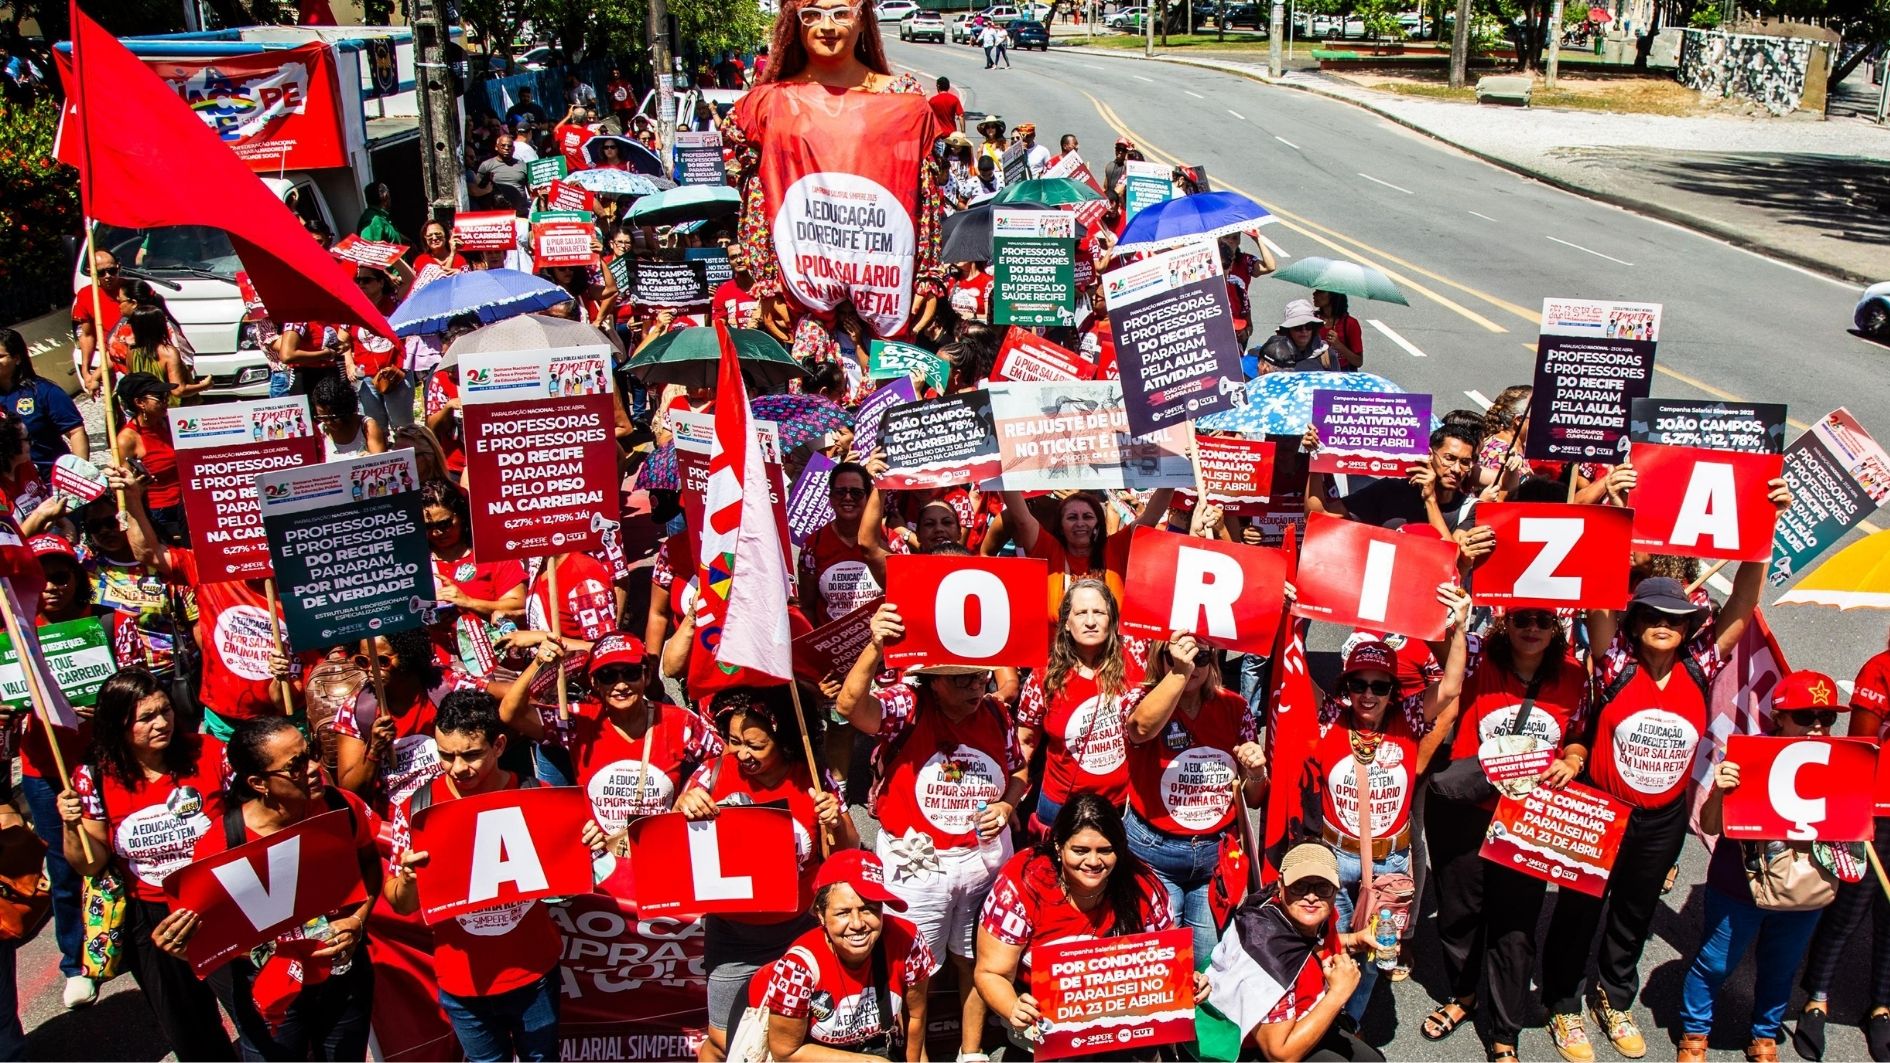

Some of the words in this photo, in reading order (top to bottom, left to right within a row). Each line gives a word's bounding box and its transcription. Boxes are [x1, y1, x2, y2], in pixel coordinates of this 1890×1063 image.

[805, 198, 812, 218] A
[812, 201, 886, 231] EDUCAÇÃO
[460, 226, 512, 236] VALORIZAÇÃO
[461, 232, 473, 240] DA
[474, 232, 512, 240] CARREIRA!
[796, 221, 817, 241] DO
[816, 225, 860, 250] RECIFE
[863, 231, 893, 254] TEM
[999, 256, 1005, 264] E
[1006, 256, 1069, 266] PROFESSORES
[1001, 247, 1066, 256] PROFESSORAS
[638, 269, 659, 278] JOÃO
[1009, 265, 1024, 273] DO
[1025, 265, 1056, 274] RECIFE
[1010, 274, 1055, 283] PARARAM
[637, 284, 647, 293] NA
[647, 285, 688, 293] CARREIRA
[688, 283, 700, 292] JÁ!
[1001, 283, 1015, 291] EM
[1017, 283, 1051, 292] DEFESA
[1052, 284, 1066, 292] DO
[1001, 289, 1032, 300] SAÚDE
[1033, 292, 1066, 301] RECIFE!
[1122, 293, 1215, 331] PROFESSORAS
[1120, 333, 1130, 345] E
[1131, 305, 1222, 344] PROFESSORES
[1141, 336, 1206, 365] PARARAM
[1547, 350, 1642, 366] PROFESSORAS
[1143, 360, 1218, 392] ATIVIDADE!
[1556, 376, 1577, 387] DO
[1579, 378, 1625, 391] RECIFE
[1556, 389, 1621, 403] PARARAM
[888, 416, 920, 434] JOÃO
[921, 406, 976, 426] CAMPOS,
[1332, 404, 1349, 414] EM
[1351, 405, 1394, 416] DEFESA
[1395, 406, 1413, 416] DA
[1551, 401, 1583, 412] PELA
[1584, 403, 1626, 416] AULA-
[481, 413, 600, 436] PROFESSORAS
[1004, 415, 1083, 438] REAJUSTE
[1087, 413, 1108, 430] DE
[1324, 414, 1420, 429] AULA-ATIVIDADE,
[1334, 426, 1388, 437] PARALISEI
[1390, 428, 1407, 438] NO
[1549, 413, 1625, 428] ATIVIDADE!
[1656, 415, 1698, 432] JOÃO
[1699, 418, 1765, 434] CAMPOS,
[476, 440, 487, 452] E
[490, 429, 606, 451] PROFESSORES
[1328, 435, 1348, 446] DIA
[1349, 436, 1361, 446] 23
[1363, 437, 1379, 448] DE
[1380, 438, 1415, 449] ABRIL!
[194, 454, 303, 476] PROFESSORAS
[497, 453, 524, 467] DO
[527, 446, 584, 465] RECIFE
[501, 461, 583, 482] PARARAM
[1797, 447, 1858, 515] PROFESSORAS
[1207, 481, 1222, 490] DE
[1223, 483, 1257, 492] ABRIL!
[1782, 471, 1800, 489] DO
[1796, 486, 1829, 522] RECIFE
[1784, 453, 1795, 464] E
[1790, 460, 1851, 526] PROFESSORES
[488, 499, 515, 515] NA
[516, 490, 604, 511] CARREIRA!
[1669, 461, 1740, 550] A
[217, 514, 257, 534] PELO
[285, 510, 408, 543] PROFESSORAS
[281, 546, 293, 557] E
[296, 522, 416, 555] PROFESSORES
[305, 552, 333, 567] DO
[336, 540, 395, 561] RECIFE
[1512, 517, 1585, 601] Z
[310, 554, 394, 580] PARARAM
[293, 581, 331, 597] POR
[334, 563, 418, 589] INCLUSÃO
[828, 582, 837, 591] DO
[837, 582, 859, 591] RECIFE
[859, 581, 873, 590] TEM
[1357, 540, 1396, 623] I
[302, 595, 328, 609] DE
[329, 577, 415, 604] VERDADE!
[1169, 546, 1244, 640] R
[935, 569, 1011, 658] O
[814, 636, 841, 652] PELO
[840, 622, 865, 639] PISO
[57, 662, 113, 686] CARREIRA!
[1860, 688, 1886, 704] CUT
[1630, 732, 1641, 744] DO
[1641, 736, 1668, 749] RECIFE
[1670, 740, 1686, 750] TEM
[1184, 762, 1190, 773] A
[1190, 759, 1227, 774] EDUCAÇÃO
[1171, 783, 1178, 793] O
[1178, 783, 1199, 797] PIOR
[1178, 773, 1189, 784] DO
[1190, 774, 1213, 785] RECIFE
[1216, 773, 1230, 784] TEM
[1344, 775, 1354, 787] DO
[1380, 776, 1394, 789] TEM
[603, 786, 615, 797] DO
[616, 787, 637, 798] RECIF
[644, 788, 660, 798] TEM
[1768, 741, 1832, 841] Ç
[924, 797, 940, 810] EM
[941, 798, 971, 810] LINHA
[1531, 787, 1553, 802] OR
[1553, 794, 1616, 823] CONDIÇÕES
[133, 825, 139, 836] A
[140, 818, 188, 836] EDUCAÇÃO
[1523, 811, 1582, 839] PARALISEI
[1582, 832, 1599, 846] NO
[1525, 799, 1544, 815] DE
[1546, 805, 1607, 836] TRABALHO,
[128, 836, 141, 848] DO
[143, 830, 175, 847] RECIFE
[177, 826, 196, 841] TEM
[468, 806, 549, 904] A
[687, 821, 754, 901] L
[211, 834, 300, 933] V
[1051, 960, 1086, 977] POR
[1087, 946, 1176, 972] CONDIÇÕES
[1060, 949, 1094, 959] Campanha
[1094, 945, 1117, 955] Salarial
[1059, 977, 1083, 991] DE
[1083, 963, 1169, 985] TRABALHO,
[1064, 982, 1138, 1004] PARALISEI
[1141, 978, 1163, 993] NO
[1057, 1005, 1085, 1020] DIA
[1086, 1001, 1103, 1015] 23
[1105, 998, 1126, 1013] DE
[1127, 990, 1175, 1010] ABRIL!
[1133, 1029, 1152, 1039] CUT
[628, 1036, 696, 1062] SIMPERE
